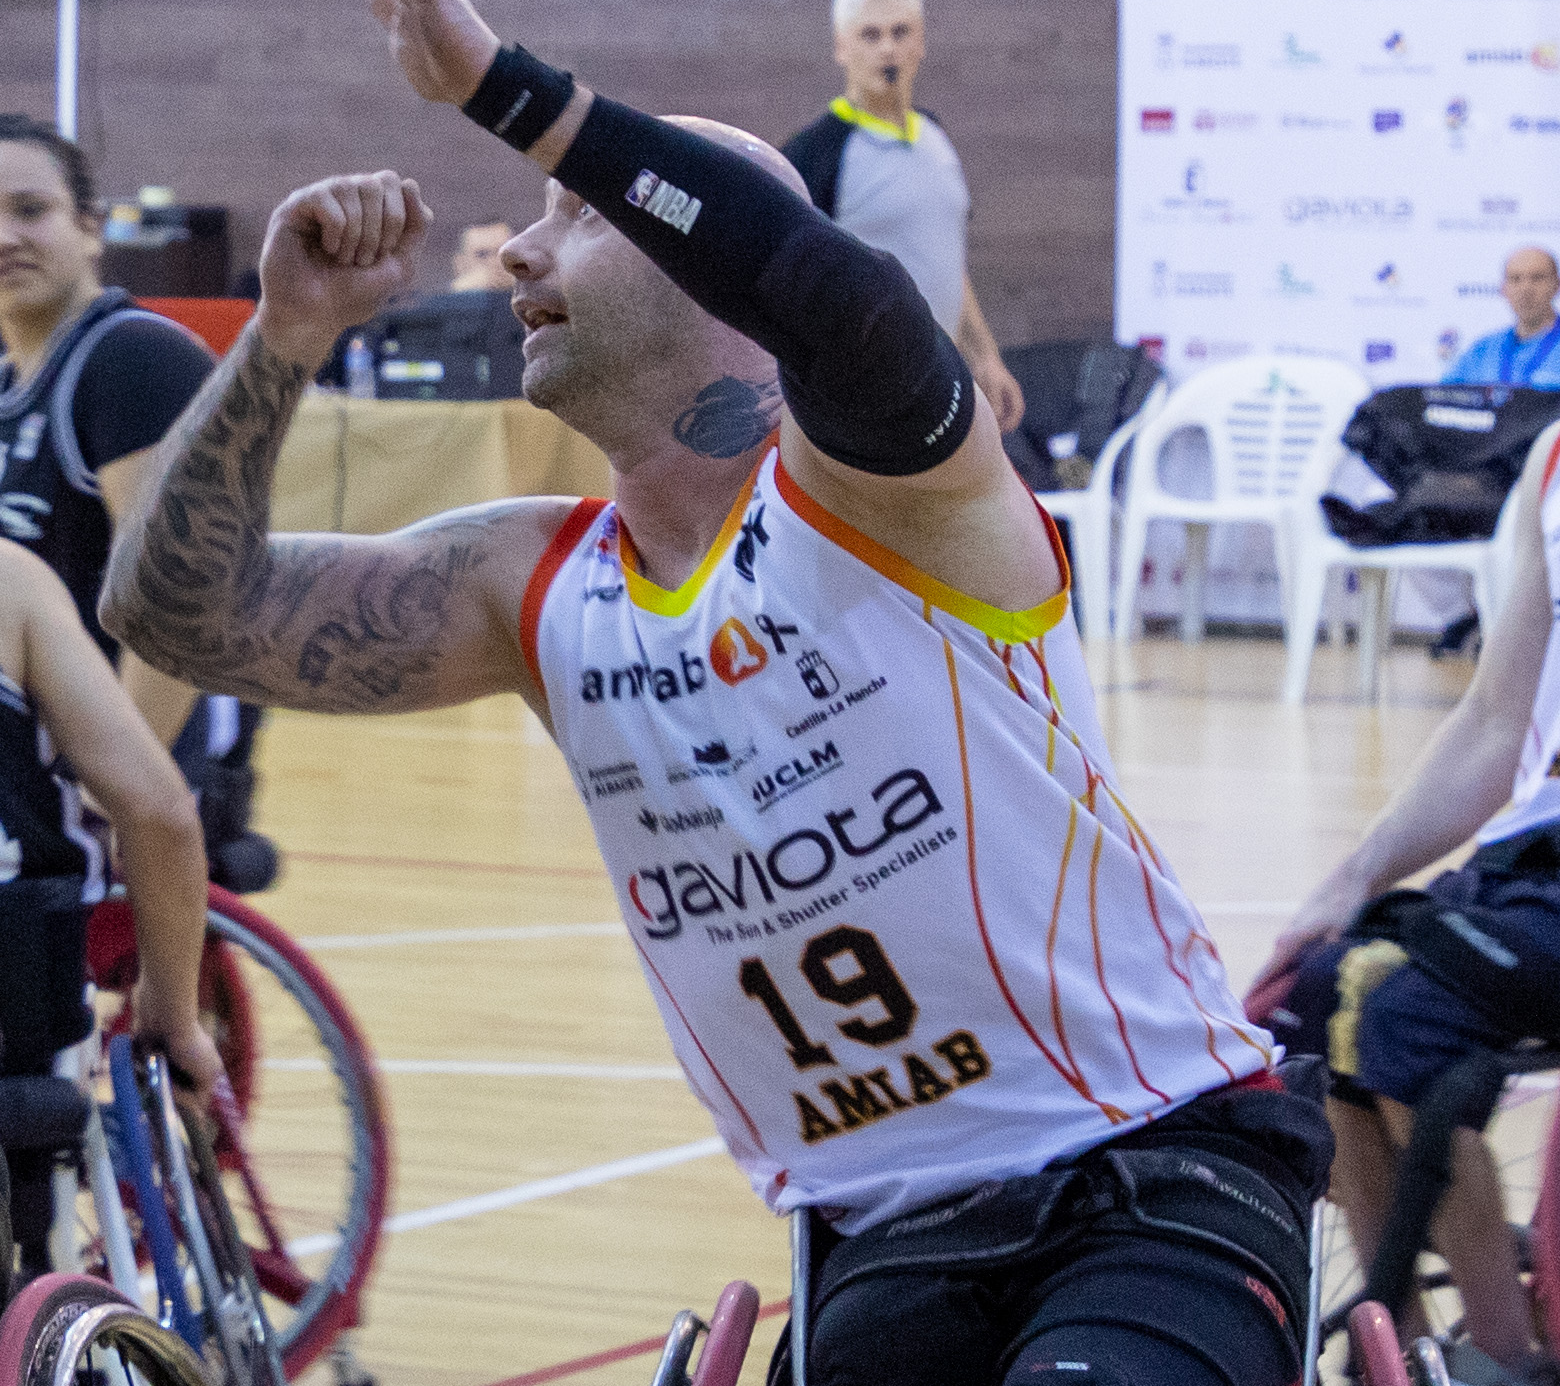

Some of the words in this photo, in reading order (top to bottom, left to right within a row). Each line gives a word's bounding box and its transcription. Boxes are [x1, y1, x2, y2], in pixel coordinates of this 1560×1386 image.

[644, 179, 703, 236] NBA
[846, 675, 888, 708] Mancha
[756, 740, 840, 803] UCLM
[628, 767, 944, 941] gaviota
[706, 923, 735, 947] The
[778, 886, 850, 932] Shutter
[853, 824, 958, 895] Specialists
[738, 923, 920, 1071] 19
[791, 1028, 993, 1146] AMIAB
